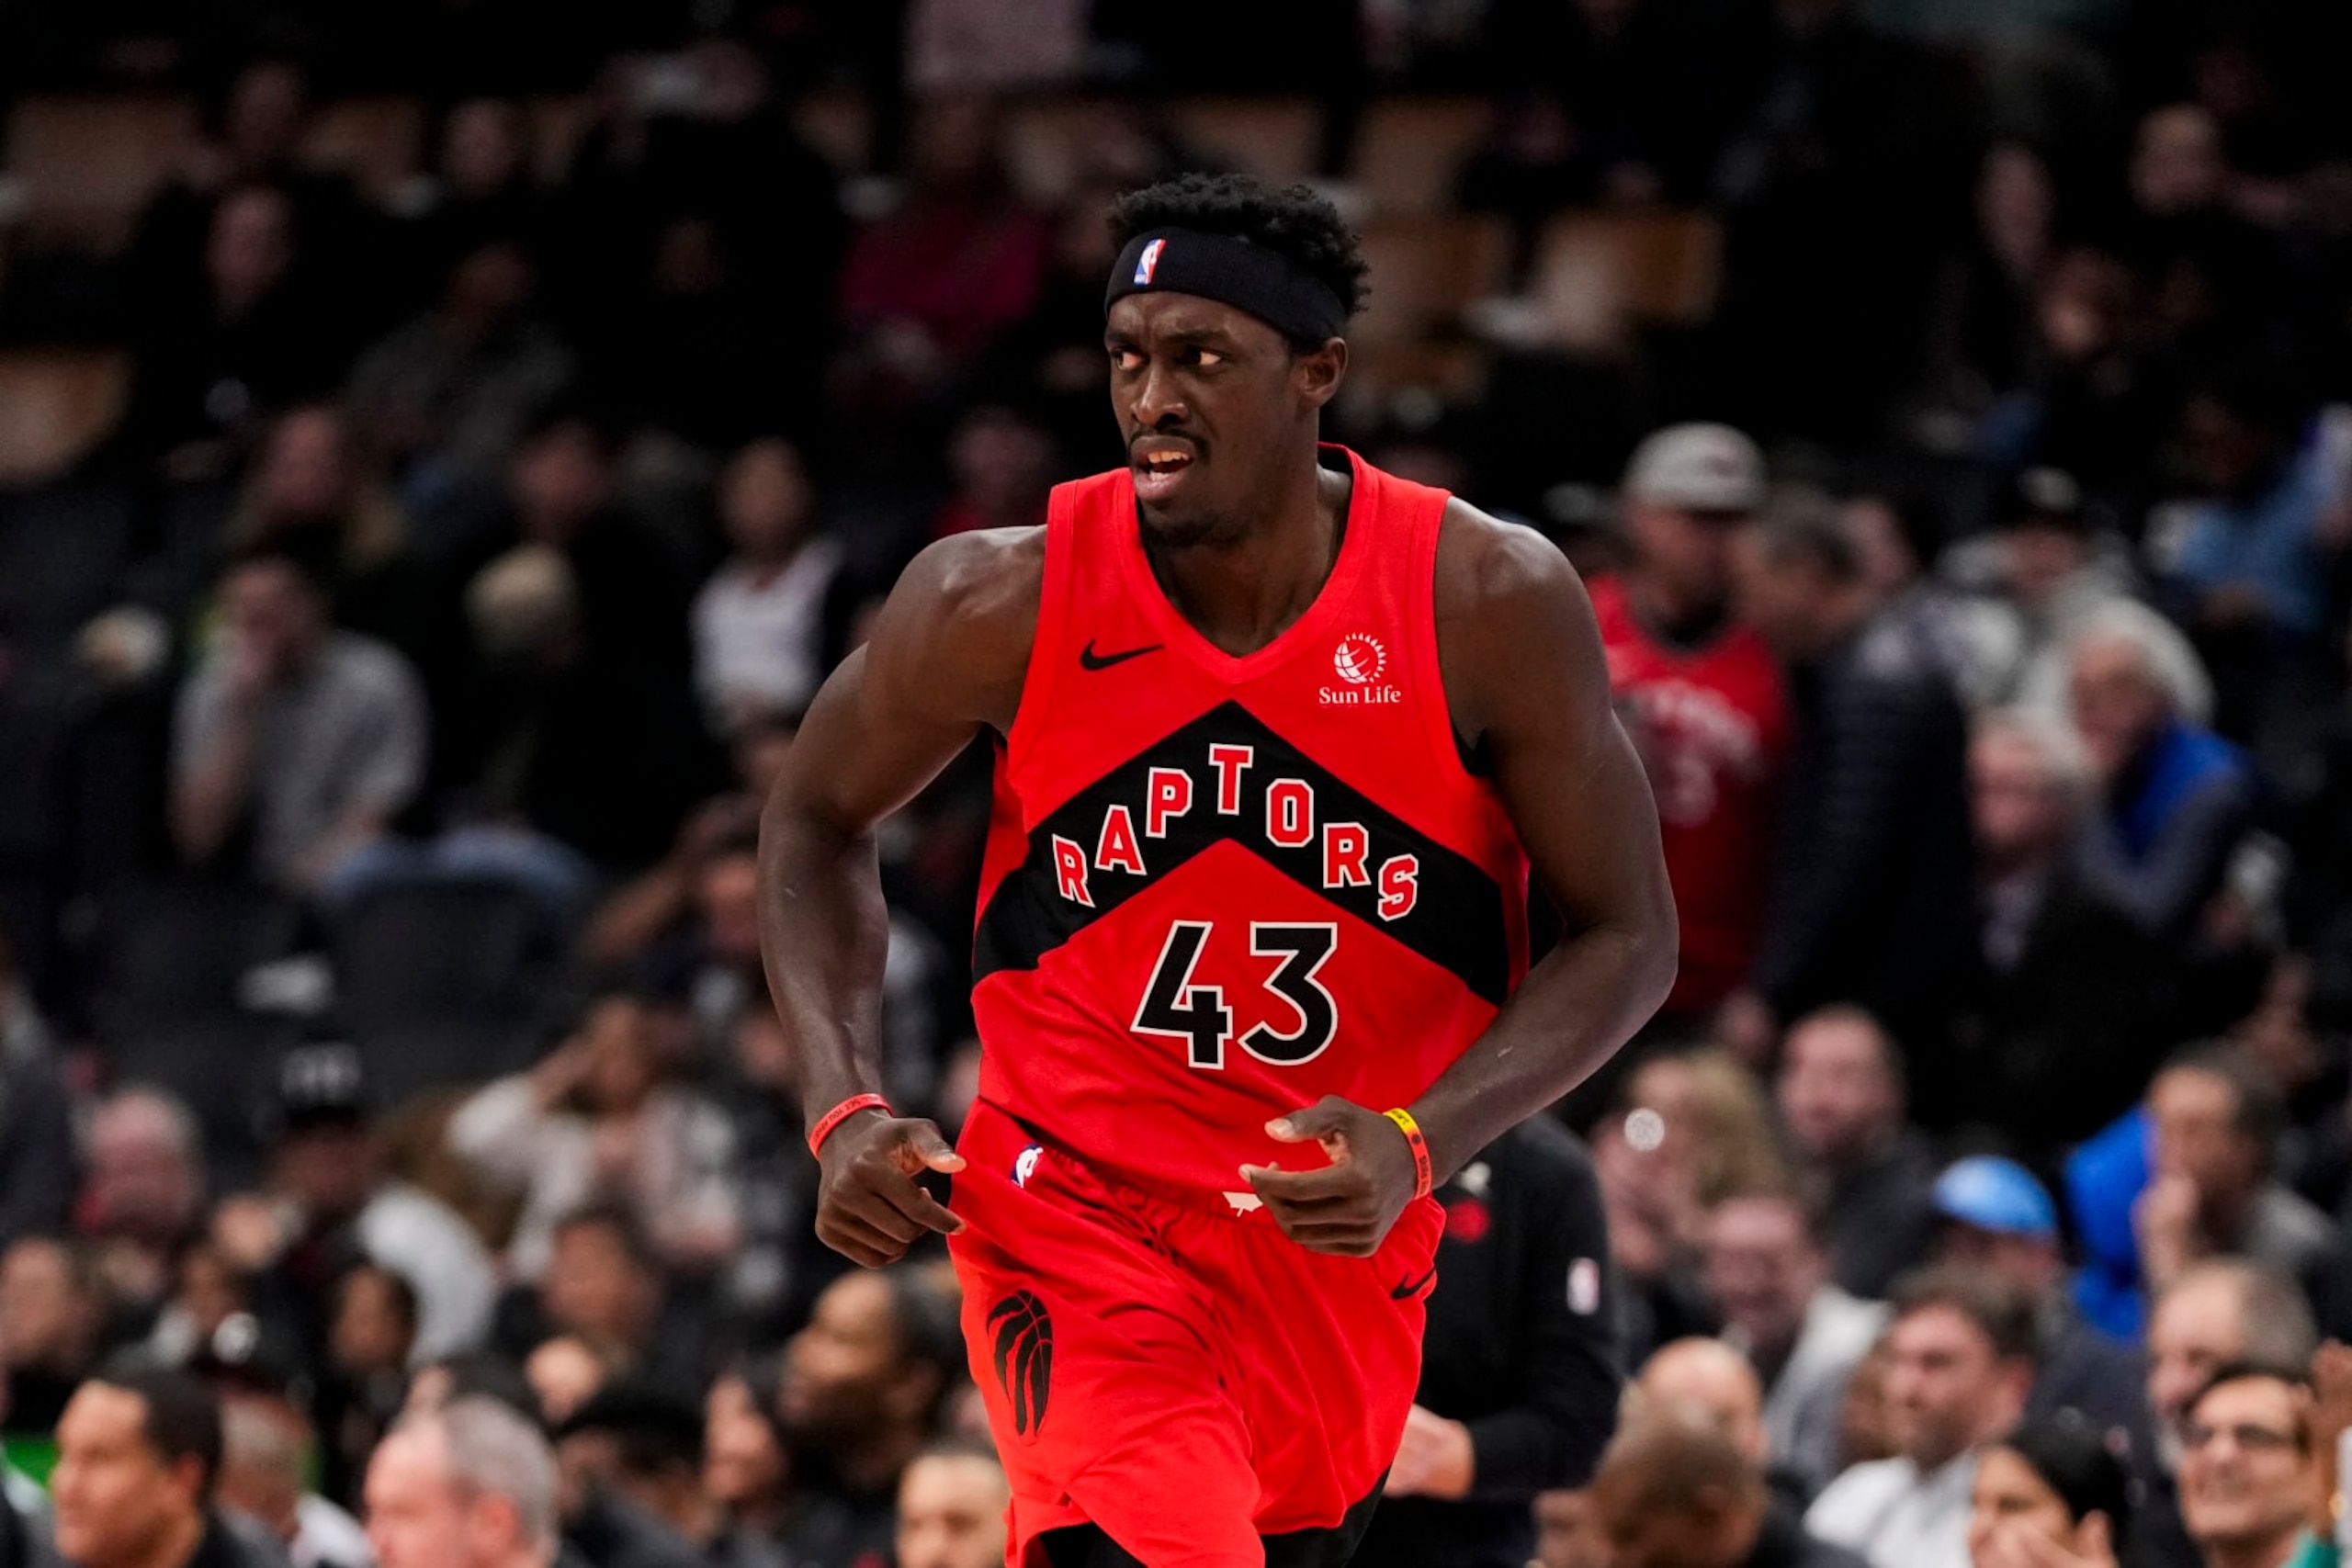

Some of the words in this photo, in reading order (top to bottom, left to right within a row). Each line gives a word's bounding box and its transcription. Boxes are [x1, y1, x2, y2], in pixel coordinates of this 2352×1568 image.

[1319, 686, 1358, 704] Sun
[1363, 684, 1401, 704] Life
[1052, 743, 1419, 921] RAPTORS
[1130, 919, 1338, 1070] 43
